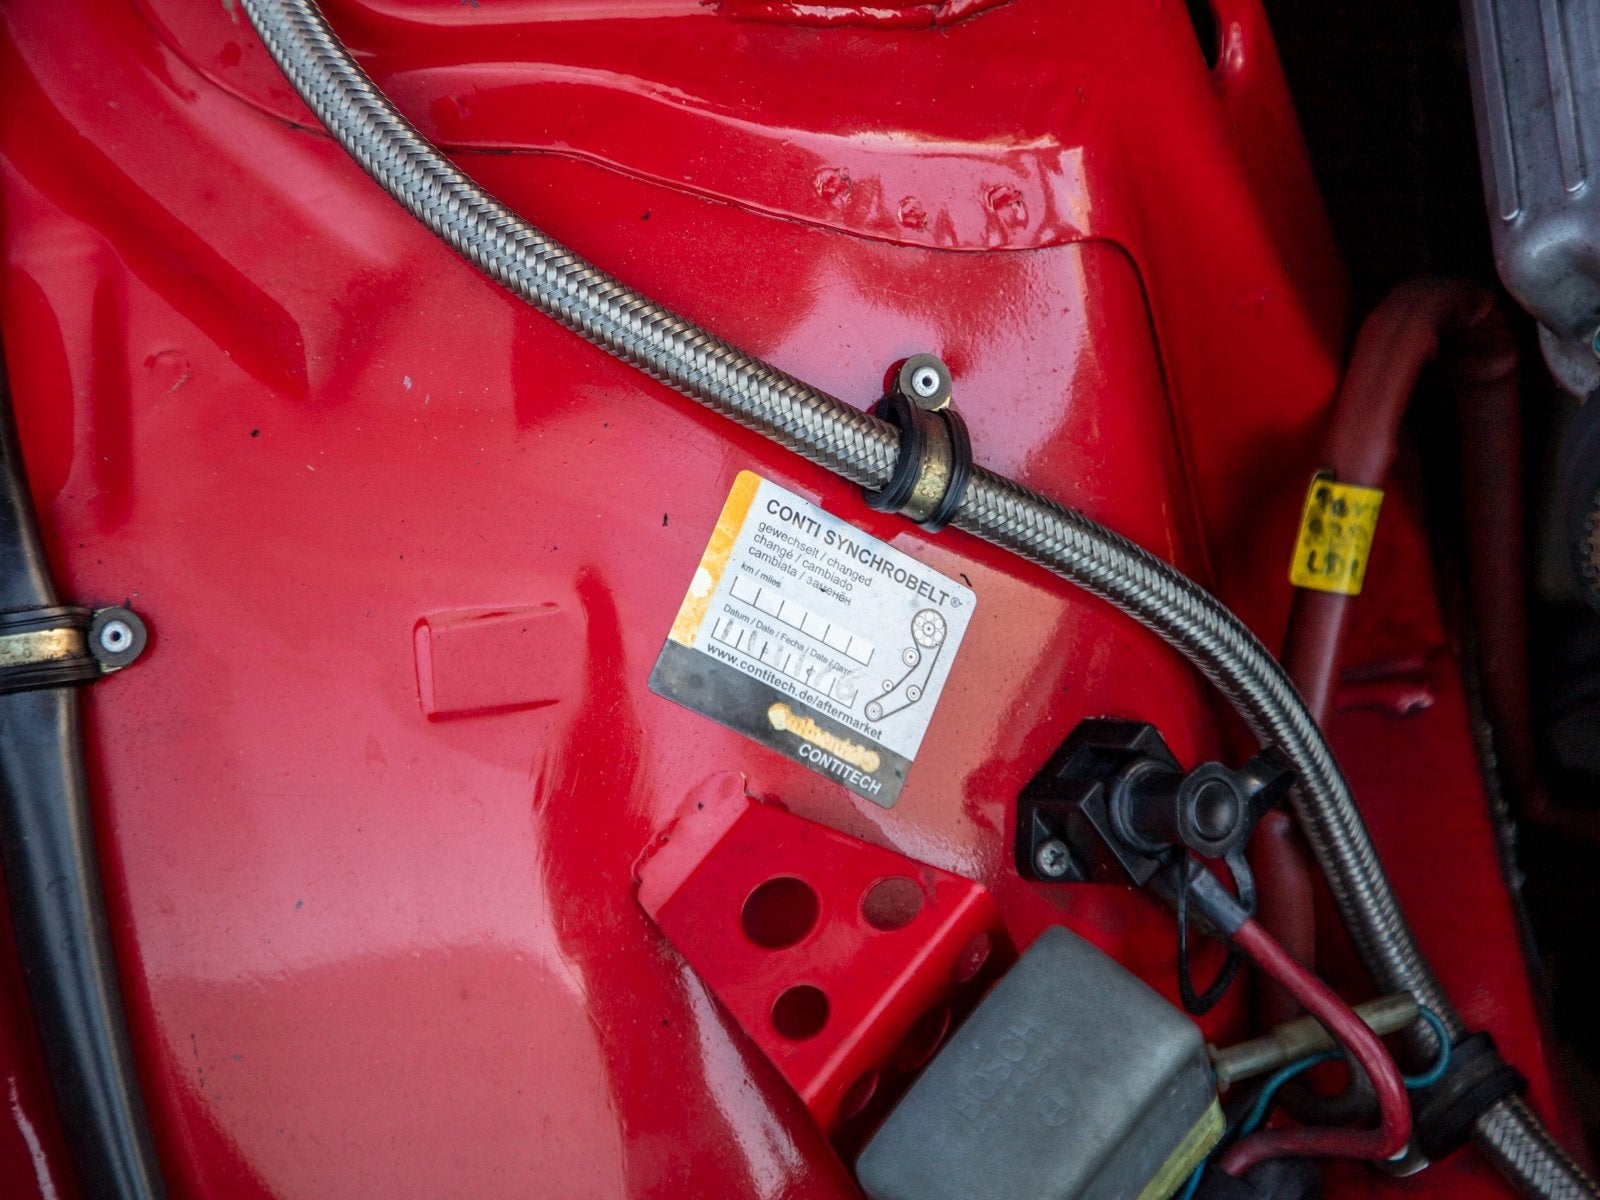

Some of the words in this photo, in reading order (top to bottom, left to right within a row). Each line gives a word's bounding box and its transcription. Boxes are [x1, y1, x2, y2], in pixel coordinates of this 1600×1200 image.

[767, 499, 821, 537] CONTI
[741, 562, 754, 573] km
[760, 573, 781, 588] miles
[748, 546, 797, 576] cambiata
[754, 534, 793, 559] changé
[802, 559, 852, 591] cambiado
[758, 522, 819, 558] gewechselt
[827, 558, 872, 587] changed
[723, 604, 750, 623] Datum
[755, 620, 774, 635] Date
[780, 633, 804, 651] Fecha
[810, 648, 828, 663] Date
[708, 643, 882, 740] www.contitech.de/aftermarket
[799, 744, 881, 794] CONTITECH
